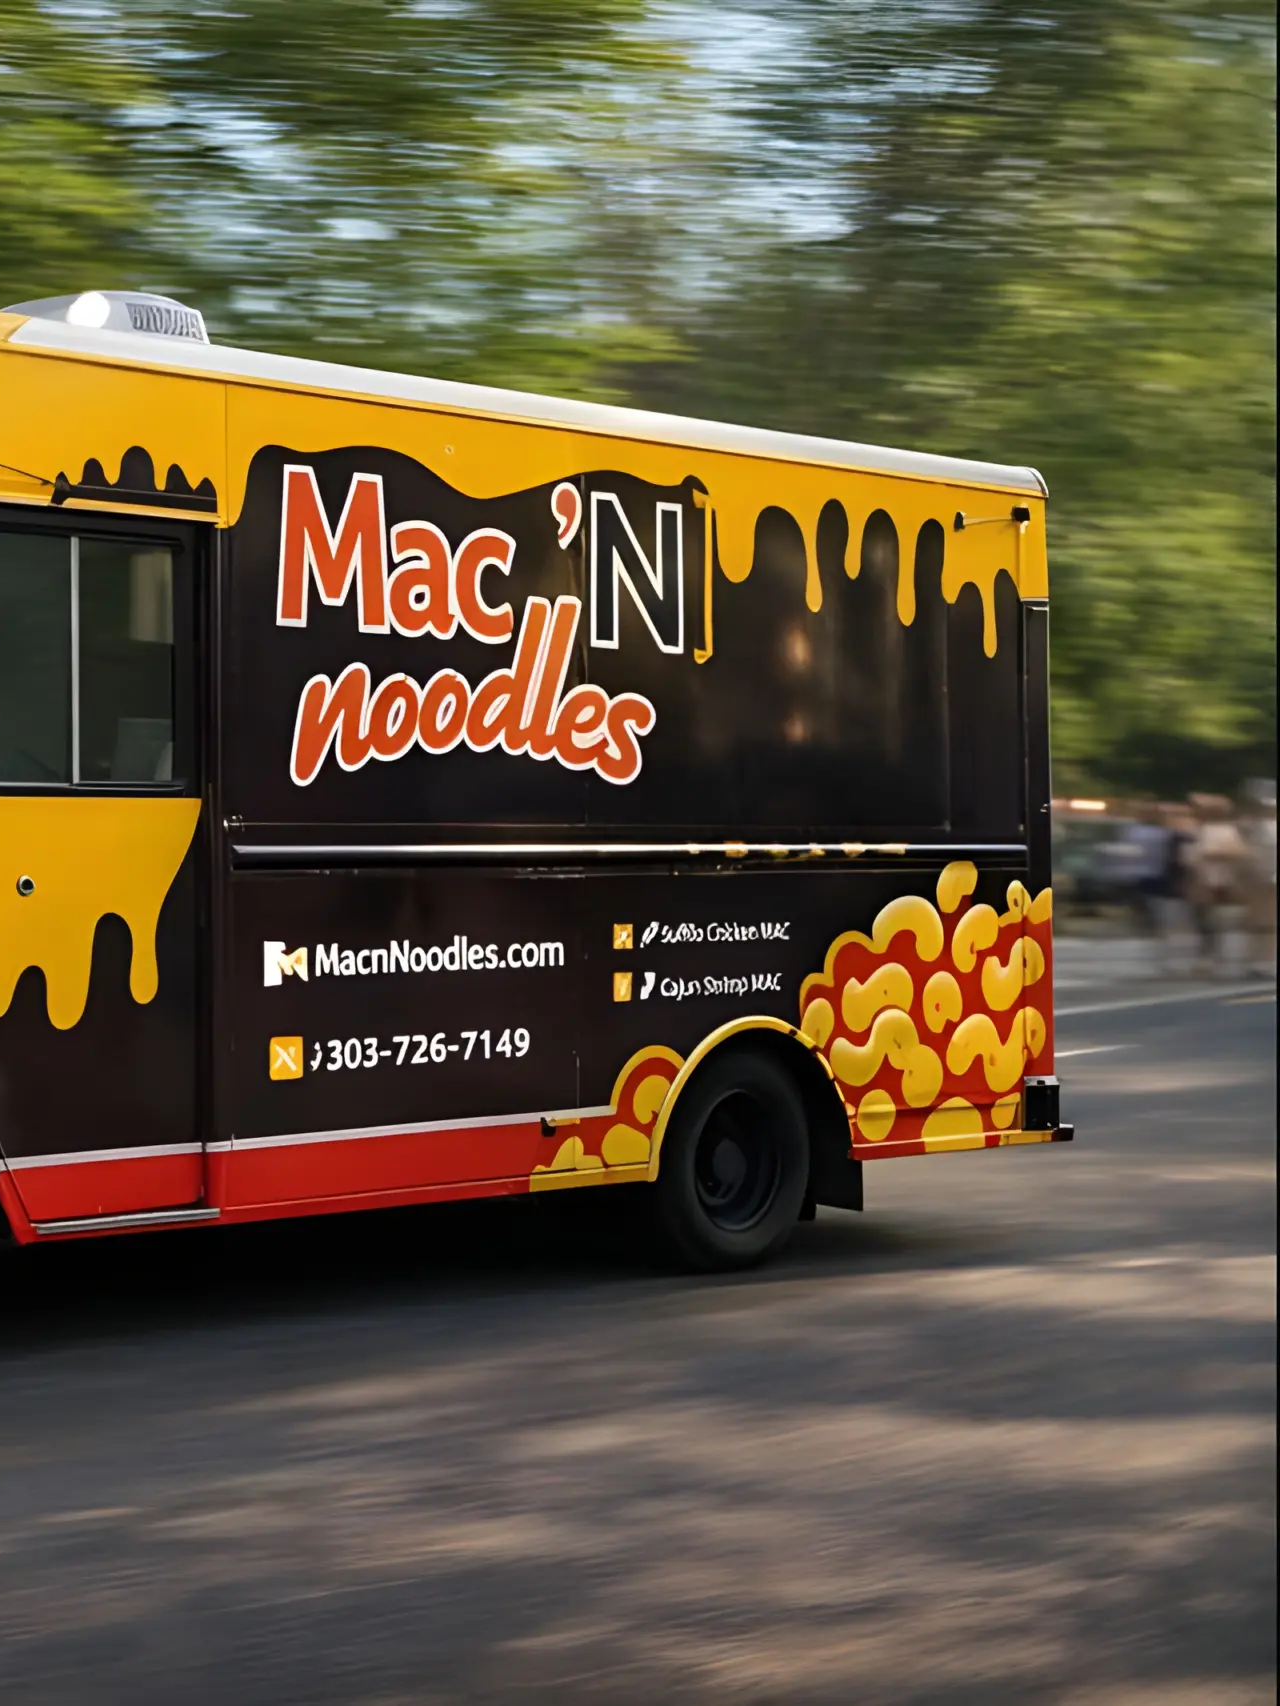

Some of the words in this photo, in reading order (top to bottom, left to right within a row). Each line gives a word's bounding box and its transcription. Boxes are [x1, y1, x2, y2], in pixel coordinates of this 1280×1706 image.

[276, 464, 516, 644] Mac
[290, 595, 656, 786] noodles
[315, 935, 565, 977] MacnNoodles.com
[326, 1027, 531, 1071] 303-726-7149
